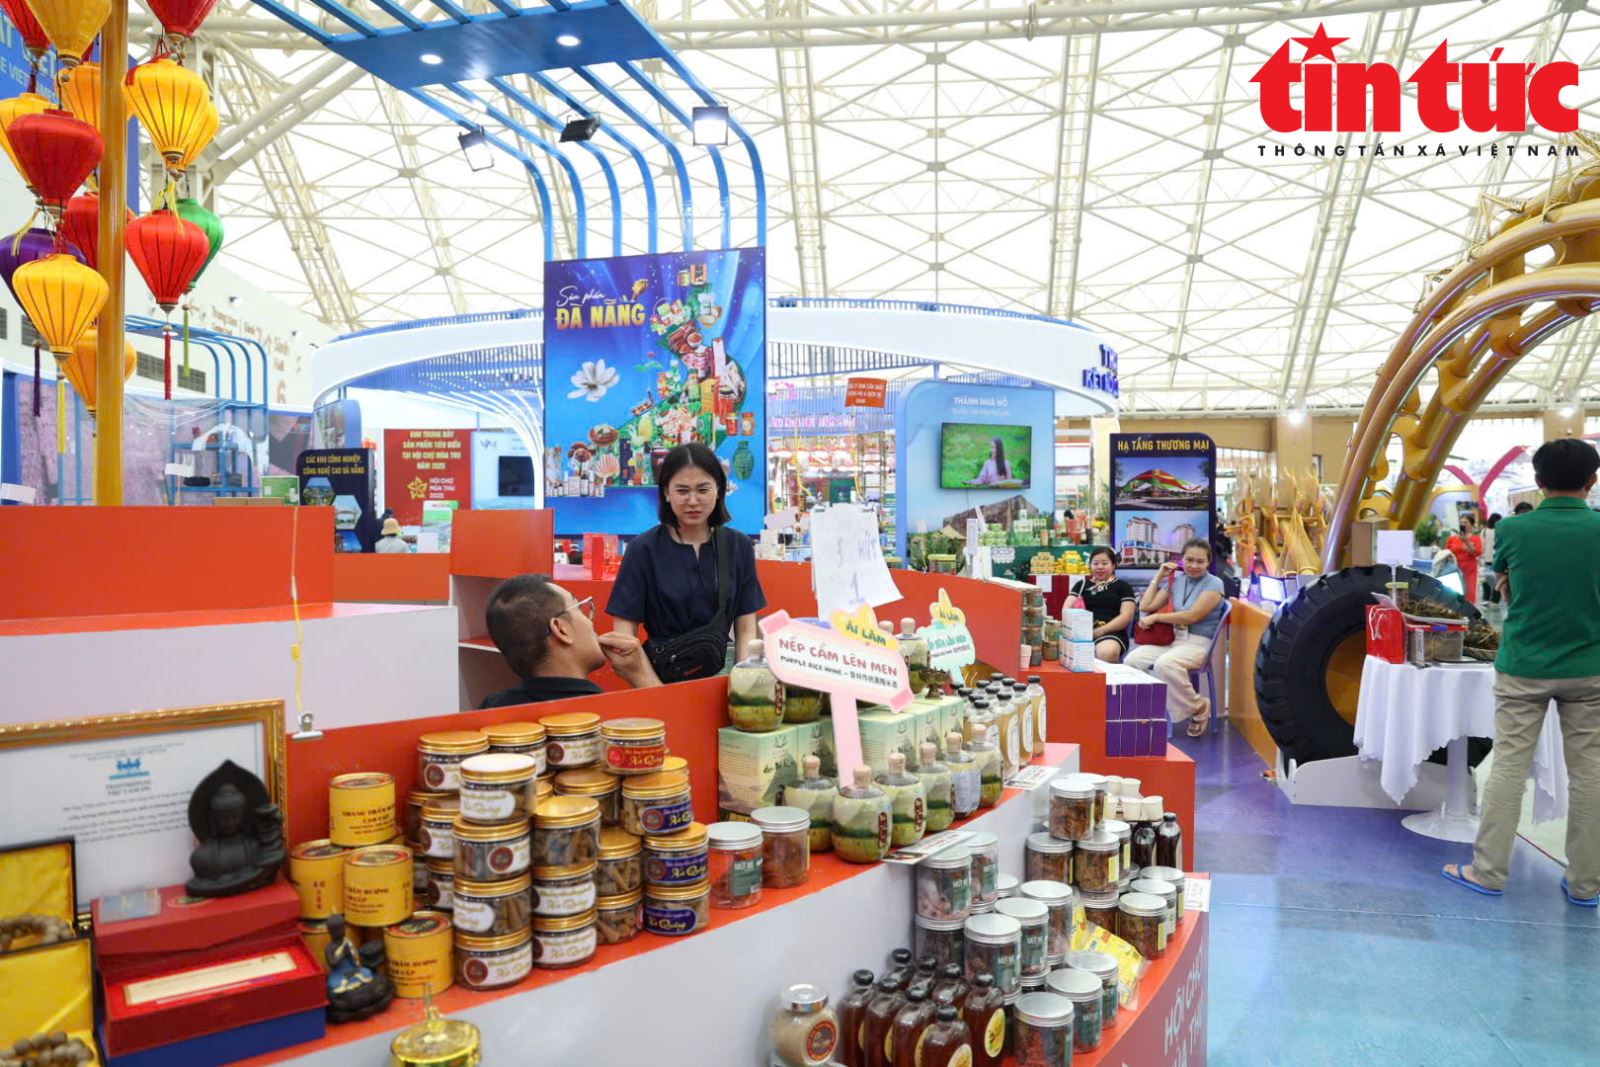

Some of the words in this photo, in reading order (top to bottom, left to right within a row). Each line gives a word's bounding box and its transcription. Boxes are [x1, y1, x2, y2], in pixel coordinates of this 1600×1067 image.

[555, 303, 583, 330] ĐÀ
[1193, 440, 1210, 452] MẠI
[778, 635, 805, 653] NẾP
[842, 653, 867, 669] LÊN
[871, 661, 898, 676] MEN
[780, 655, 806, 667] PURPLE
[808, 661, 823, 672] RICE
